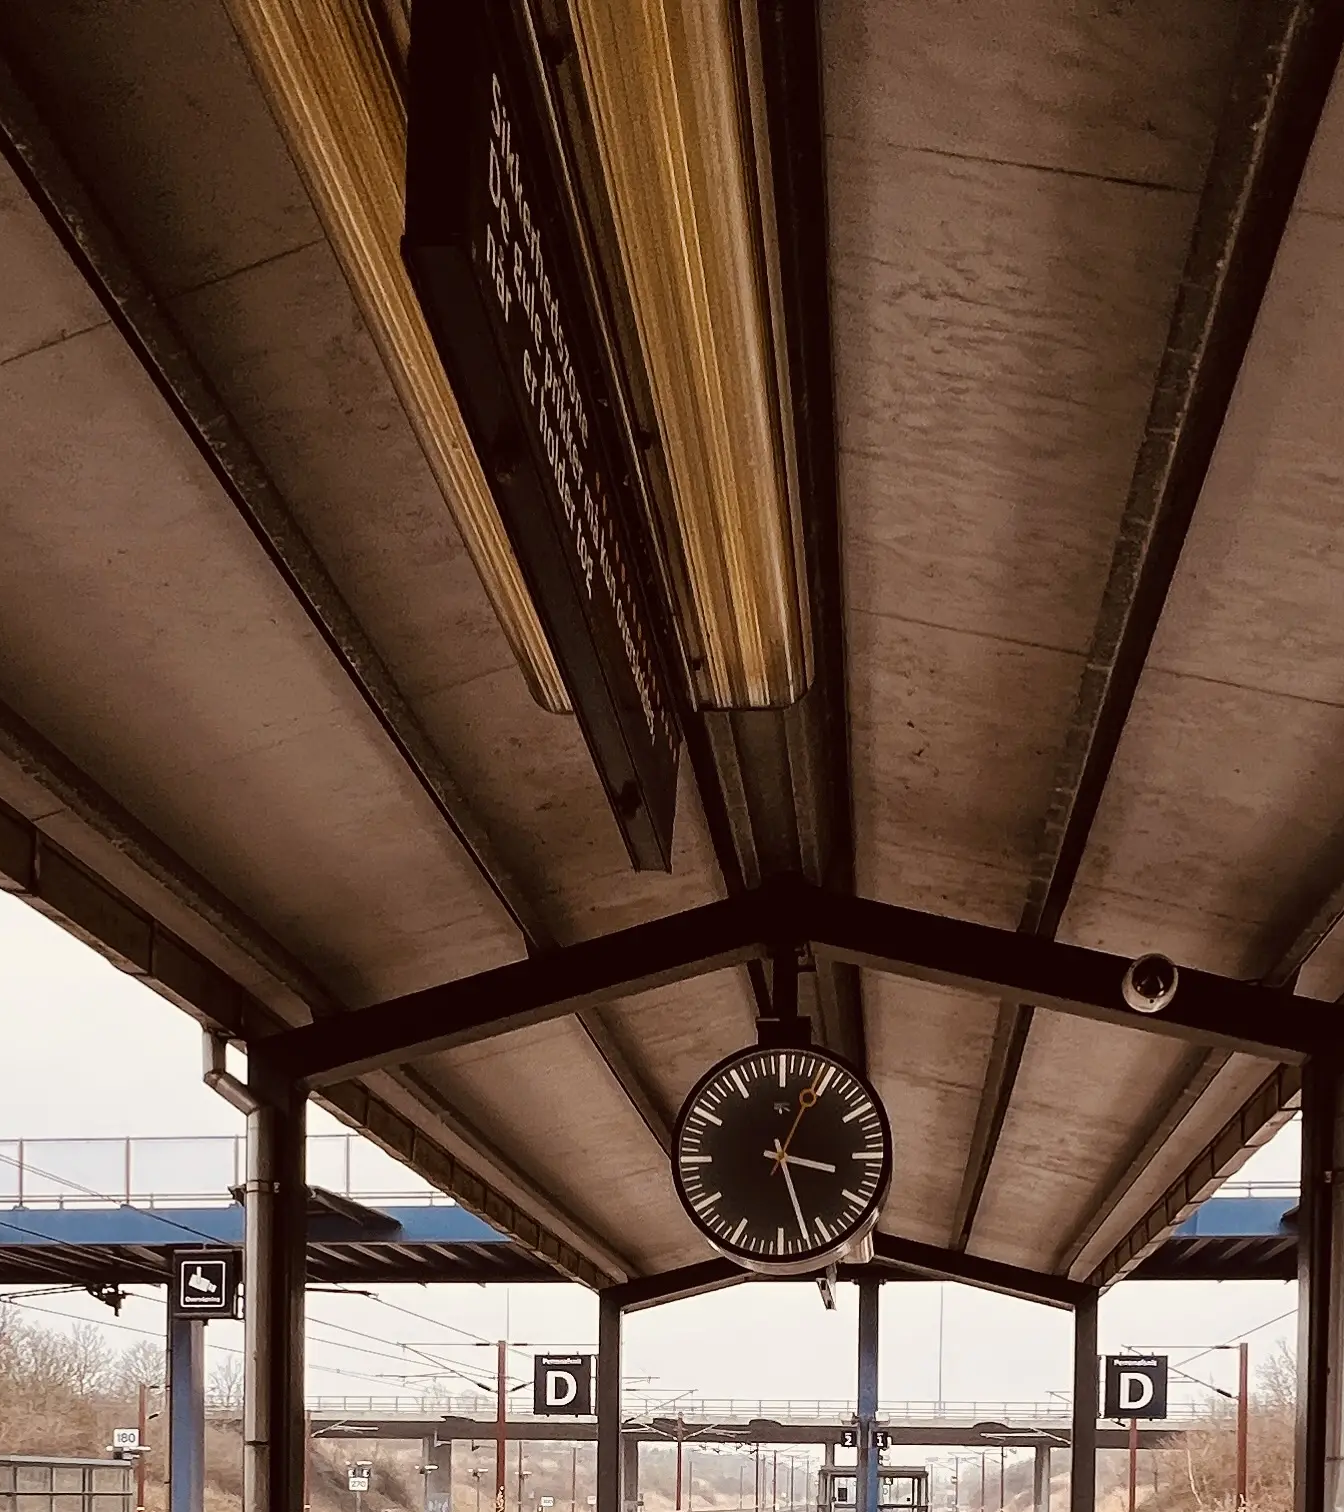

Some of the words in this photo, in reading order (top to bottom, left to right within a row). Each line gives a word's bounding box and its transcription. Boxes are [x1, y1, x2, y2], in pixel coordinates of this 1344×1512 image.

[490, 72, 588, 449] Sikkerhedszone
[486, 223, 512, 323] når
[539, 385, 575, 531] holder
[576, 518, 593, 600] tog
[488, 138, 510, 245] De
[513, 240, 542, 356] gule
[544, 347, 583, 490] prikker
[584, 484, 599, 550] må
[600, 528, 616, 608] kun
[117, 1432, 136, 1443] 180
[546, 1371, 577, 1406] D
[1119, 1372, 1153, 1409] D
